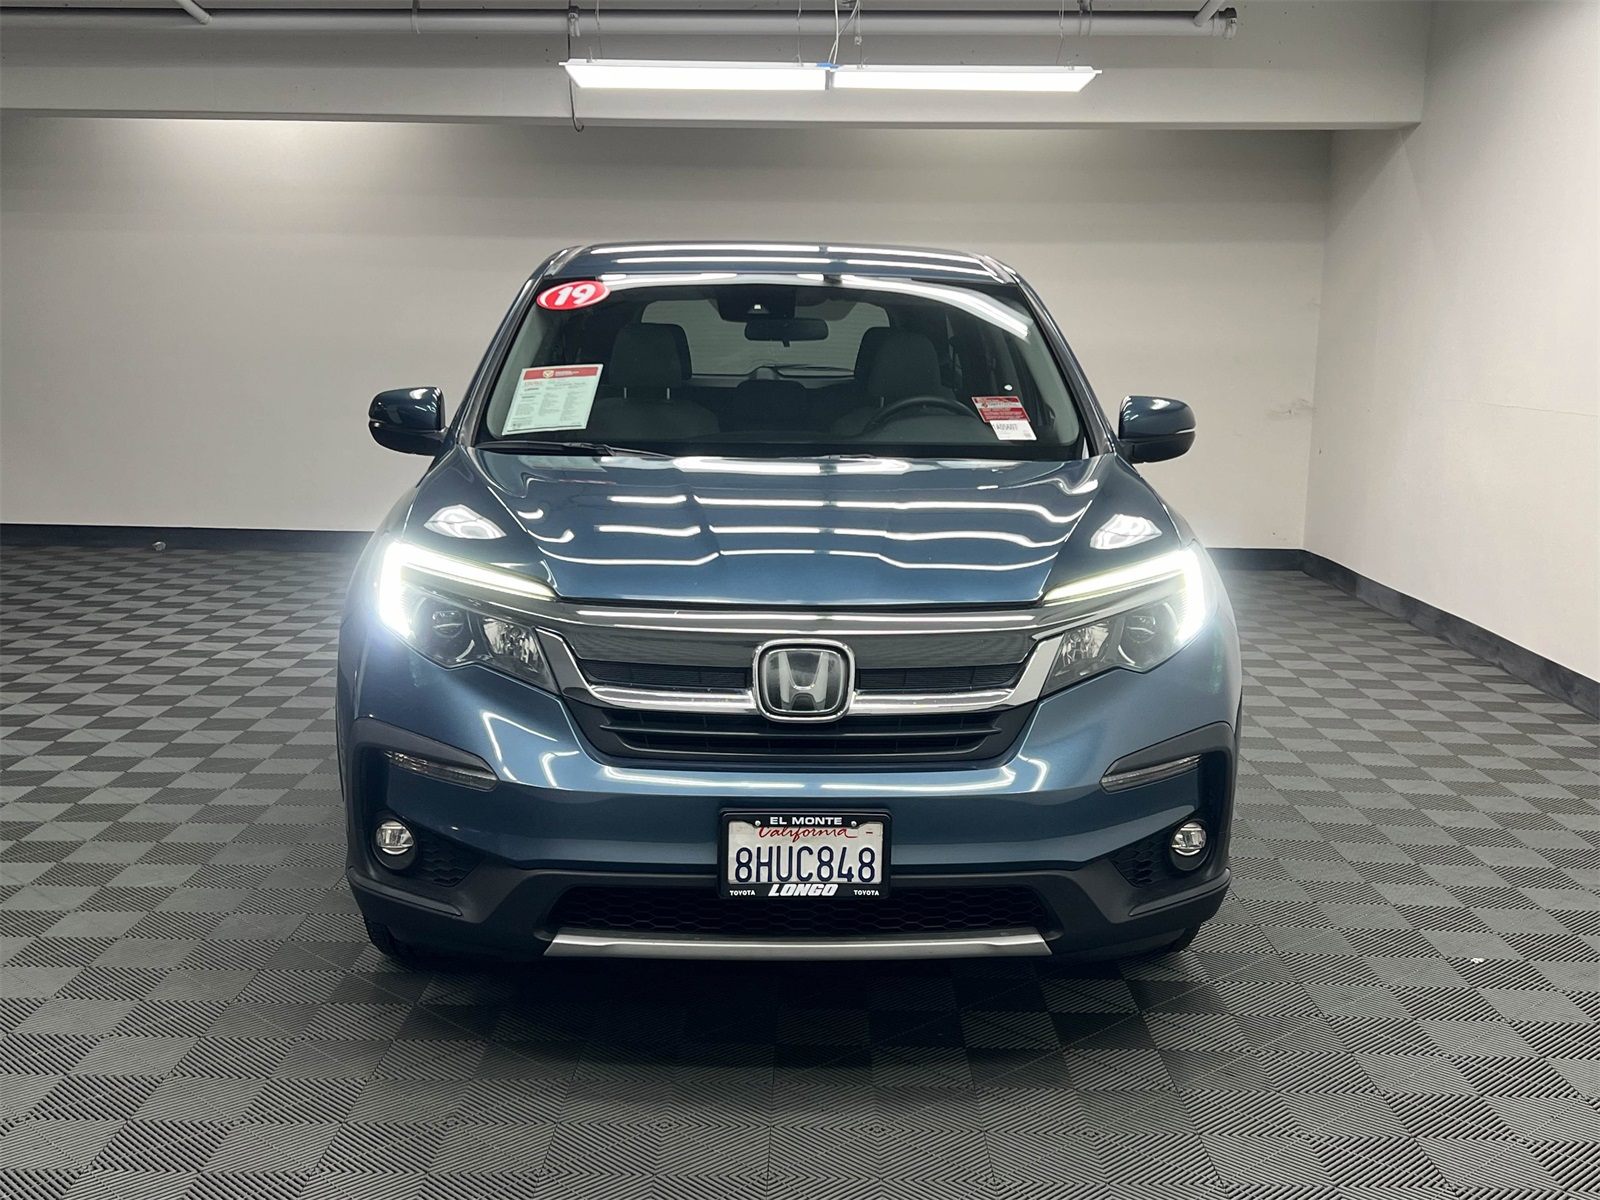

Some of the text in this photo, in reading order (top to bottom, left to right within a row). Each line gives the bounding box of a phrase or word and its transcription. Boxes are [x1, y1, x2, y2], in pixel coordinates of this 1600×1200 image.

[554, 283, 596, 306] 19
[769, 817, 843, 825] EL MONTE
[758, 826, 858, 843] California
[735, 845, 876, 883] 8HUC848
[768, 884, 839, 897] LONGO
